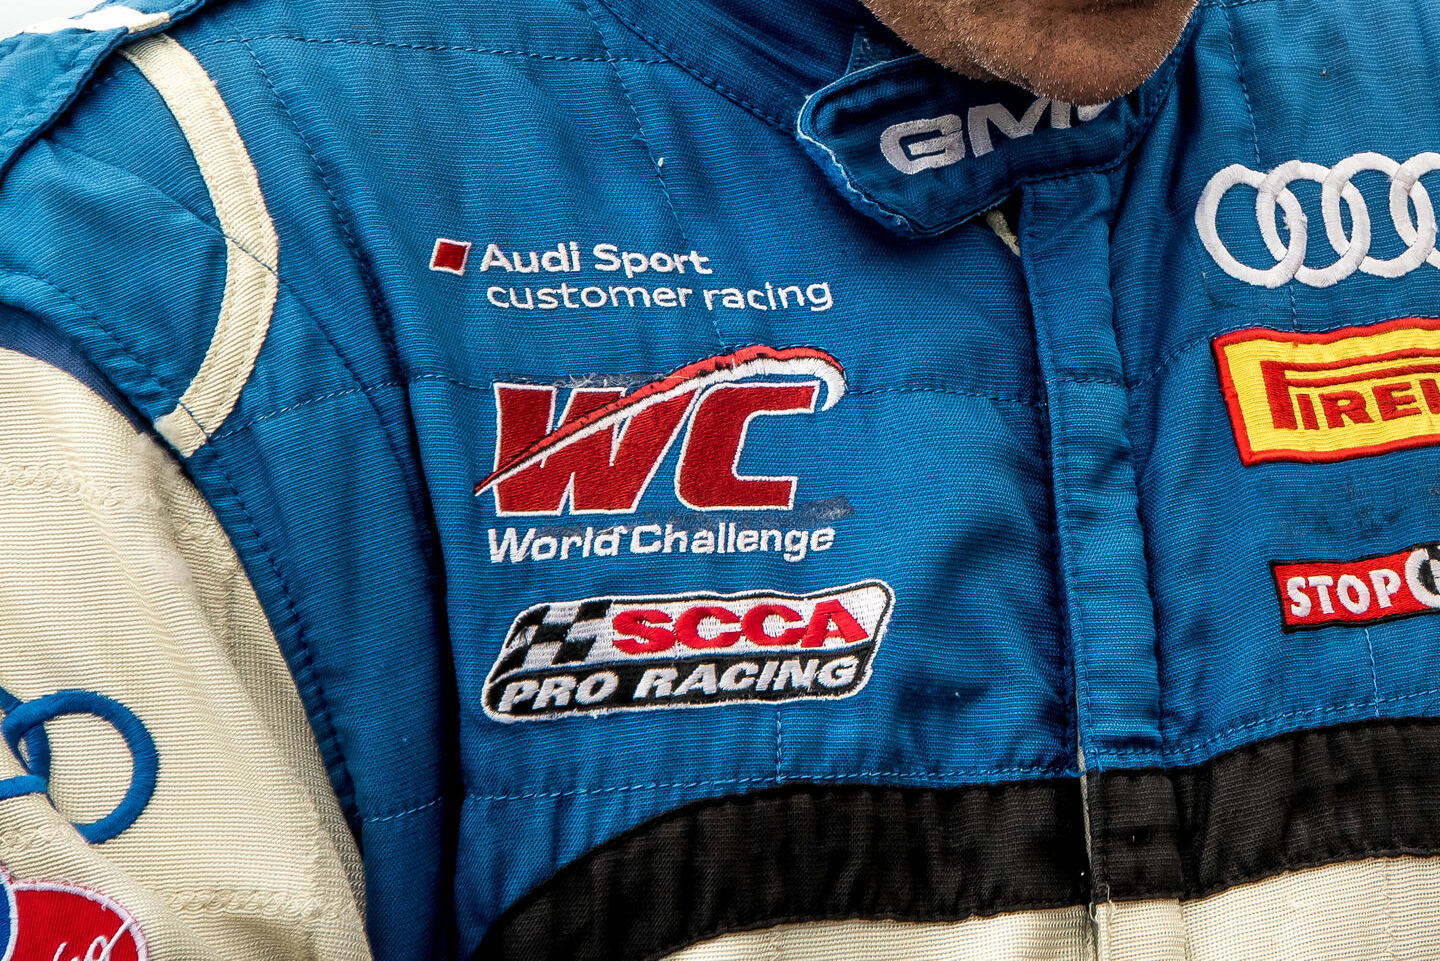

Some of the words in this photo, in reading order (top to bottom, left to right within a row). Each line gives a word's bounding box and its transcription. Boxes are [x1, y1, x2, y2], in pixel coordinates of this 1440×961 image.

[880, 96, 1112, 175] GM
[479, 240, 581, 274] Audi
[592, 242, 713, 279] Sport
[486, 282, 693, 311] customer
[702, 280, 834, 312] racing
[493, 380, 822, 518] WC
[487, 524, 619, 565] World
[629, 524, 836, 563] Challenge
[611, 598, 870, 656] SCCA
[496, 670, 619, 713] PRO
[633, 653, 857, 701] RACING
